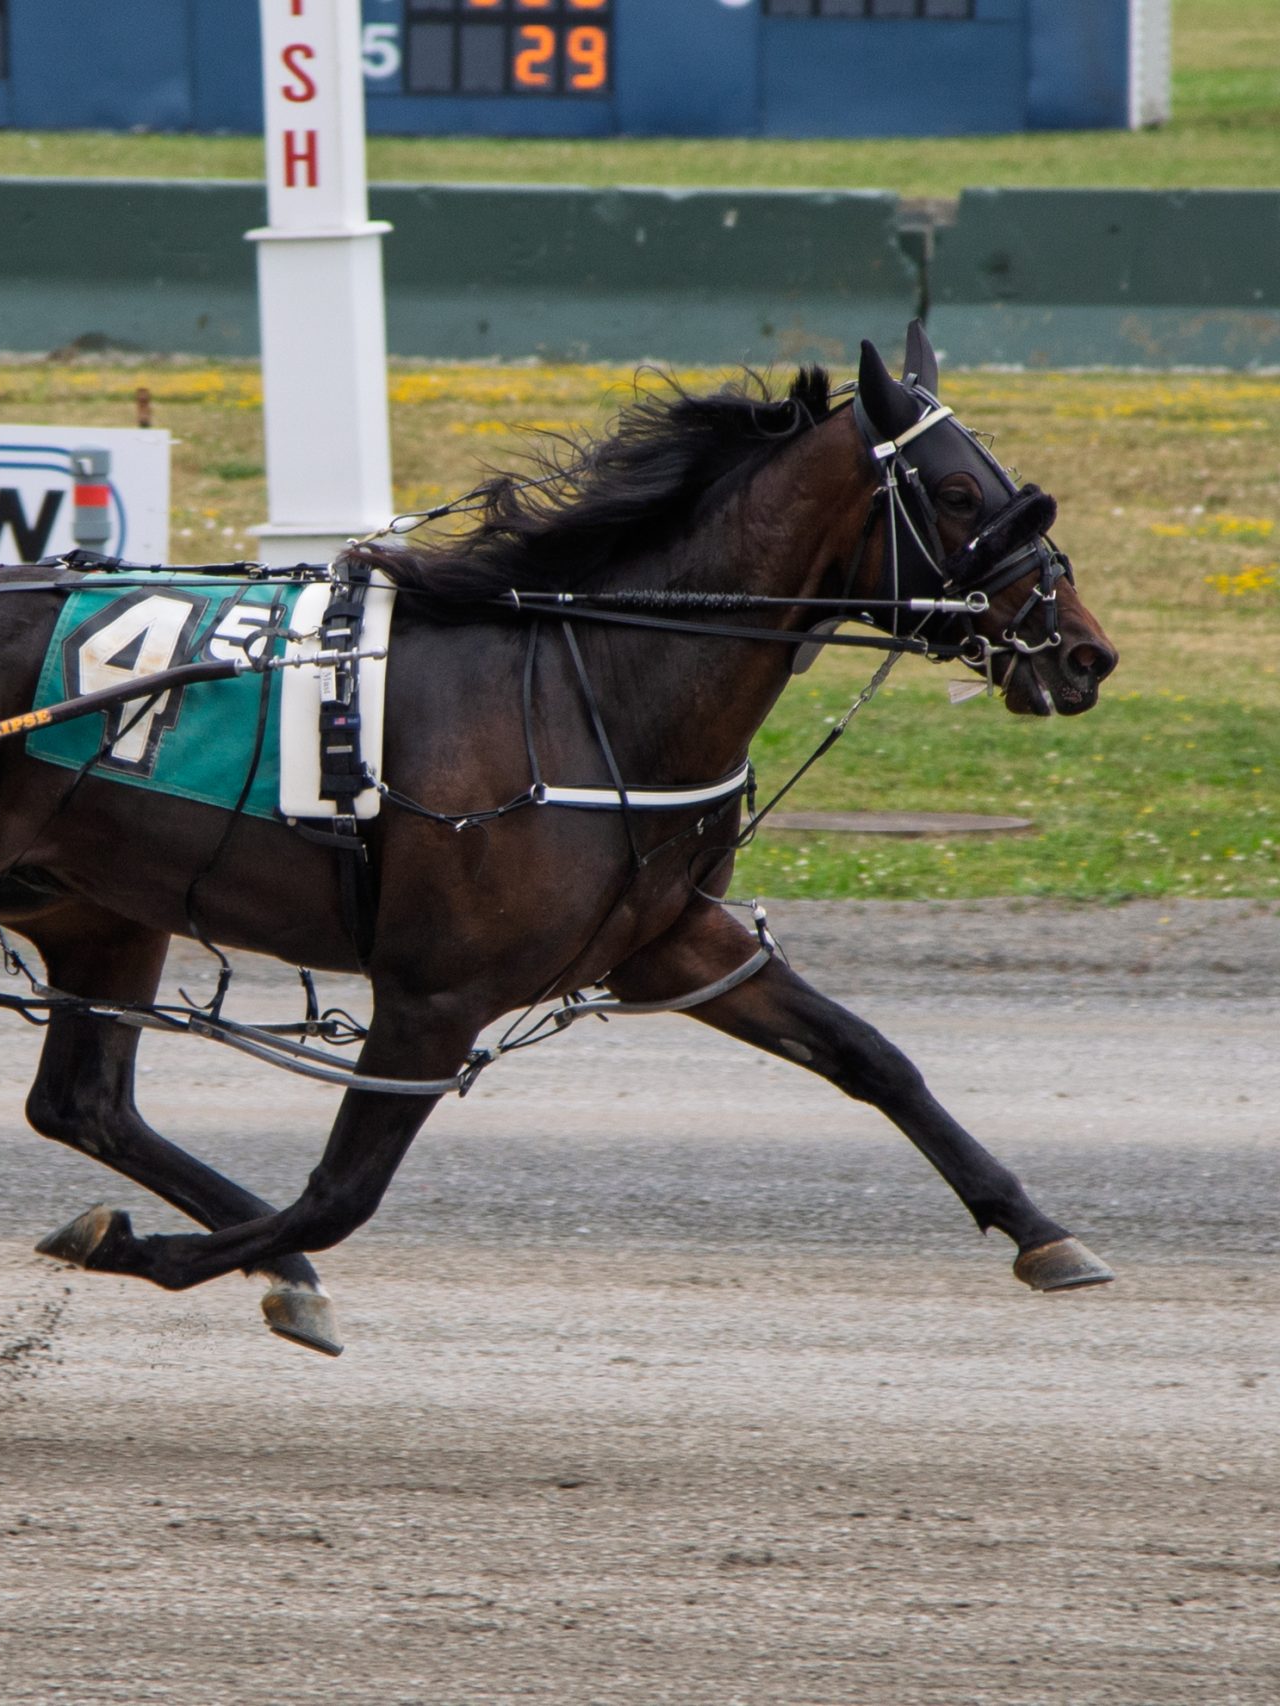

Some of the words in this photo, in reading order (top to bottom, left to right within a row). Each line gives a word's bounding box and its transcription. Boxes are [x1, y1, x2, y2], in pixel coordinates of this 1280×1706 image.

[281, 0, 318, 188] SH
[361, 22, 400, 78] 5
[514, 24, 607, 89] 29
[73, 591, 201, 770] 4
